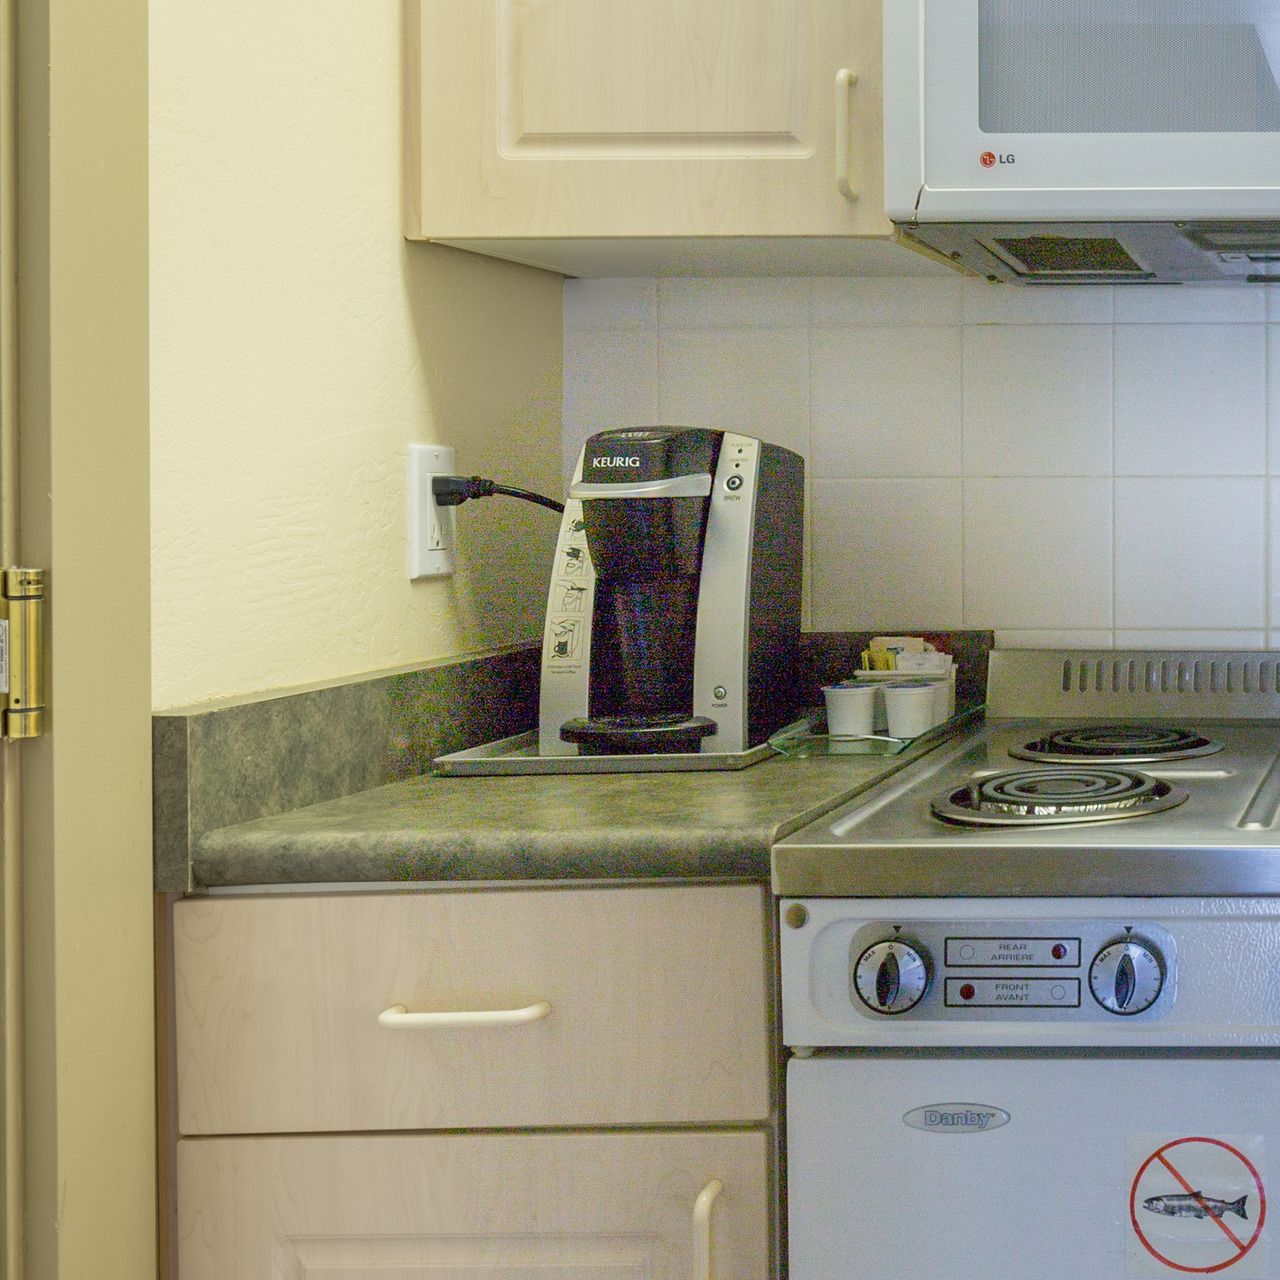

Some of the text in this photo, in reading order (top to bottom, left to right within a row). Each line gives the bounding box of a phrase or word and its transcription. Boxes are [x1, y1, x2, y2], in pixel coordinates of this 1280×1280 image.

[999, 154, 1015, 164] LG
[592, 457, 640, 468] KEURIG
[863, 950, 876, 962] MAX
[906, 951, 917, 962] MIN
[1098, 951, 1111, 963] MAX
[1142, 951, 1154, 964] MIN
[995, 983, 1030, 991] FRONT
[995, 993, 1030, 1001] AVANT
[924, 1110, 991, 1128] Danby
